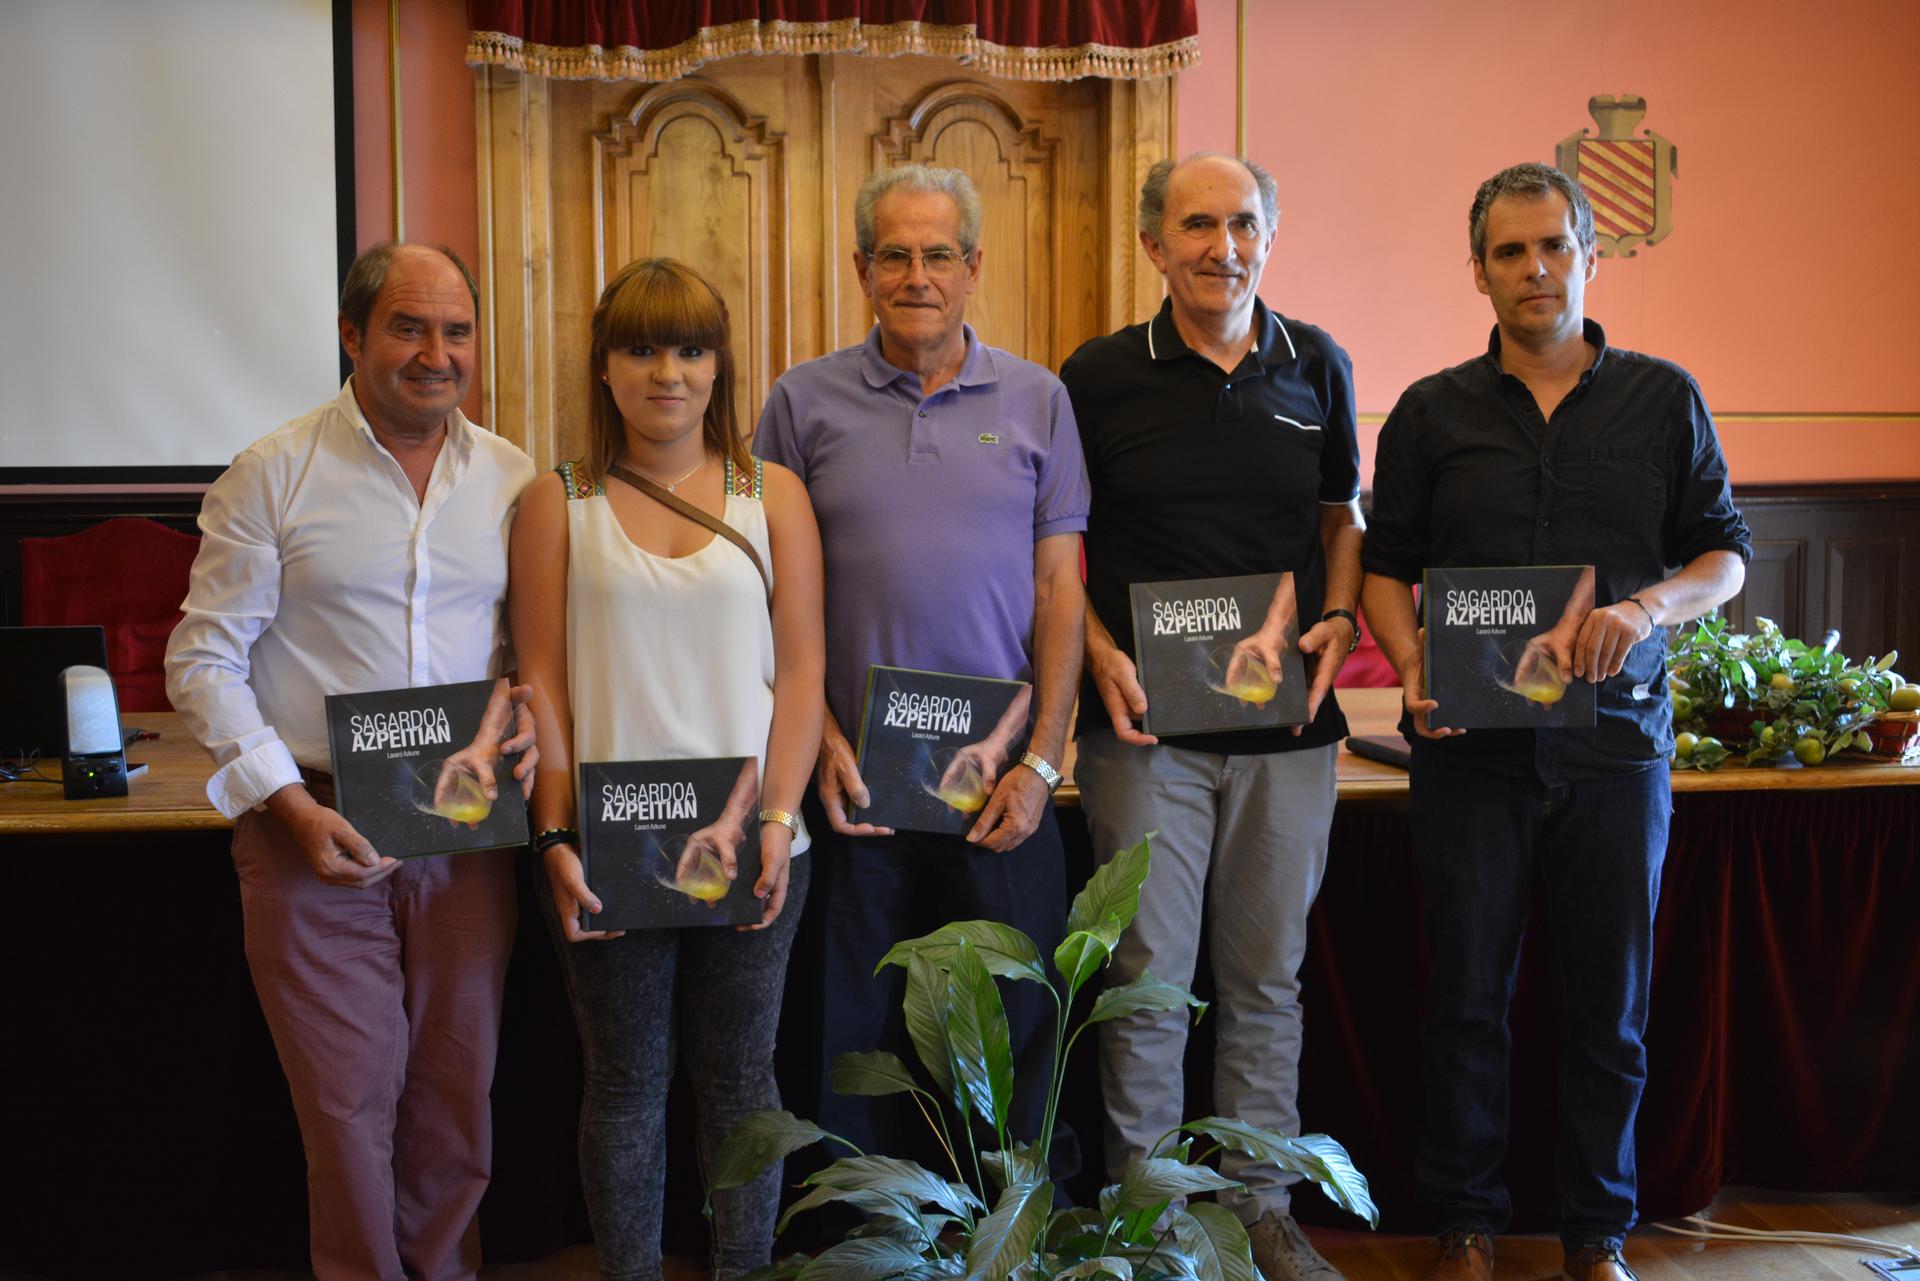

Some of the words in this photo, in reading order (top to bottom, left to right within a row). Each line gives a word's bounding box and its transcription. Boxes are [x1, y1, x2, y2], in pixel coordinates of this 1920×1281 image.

[1152, 596, 1239, 619] SAGARDOA
[1446, 590, 1535, 609] SAGARDOA
[1153, 612, 1242, 636] AZPEITIAN
[1445, 607, 1536, 626] AZPEITIAN
[887, 691, 971, 717] SAGARDOA
[350, 707, 449, 735] SAGARDOA
[883, 707, 972, 735] AZPEITIAN
[352, 724, 451, 753] AZPEITIAN
[602, 782, 697, 804] SAGARDOA
[601, 799, 698, 822] AZPEITIAN
